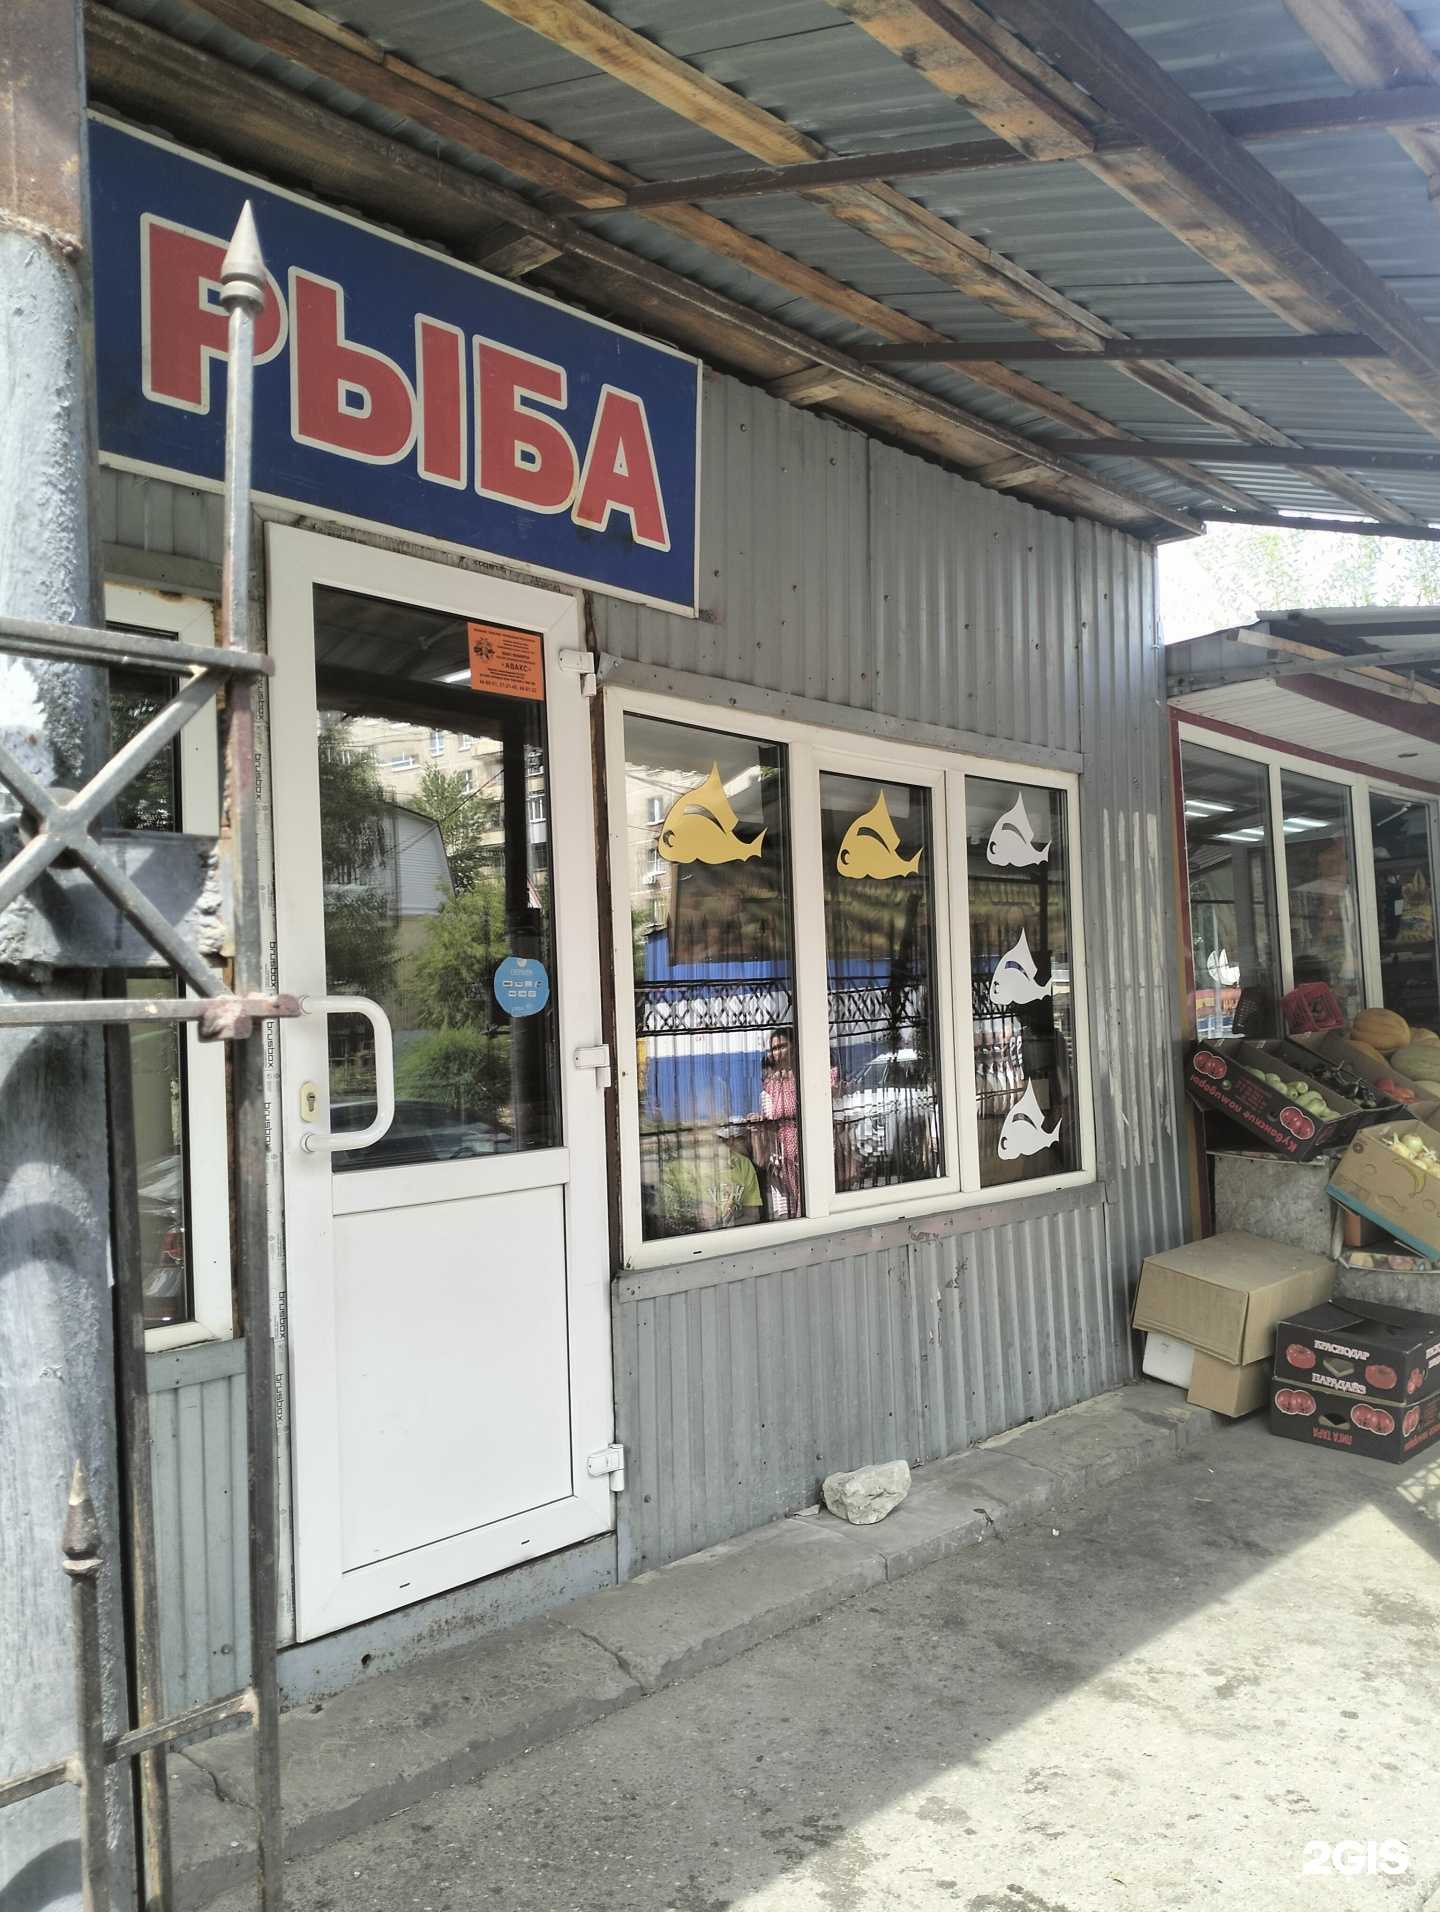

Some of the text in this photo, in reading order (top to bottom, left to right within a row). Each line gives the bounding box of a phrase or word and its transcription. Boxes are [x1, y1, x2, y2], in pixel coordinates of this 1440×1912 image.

[140, 212, 671, 553] РЫБА
[269, 941, 279, 988] brusbox
[266, 1021, 275, 1069] brusbox
[263, 1102, 272, 1152] brusbox
[279, 1291, 287, 1339] brusbox
[1313, 1340, 1370, 1360] КРАСНОДАР
[275, 1373, 284, 1421] brusbox
[1311, 1373, 1367, 1395] ПАРАДАЙЗ
